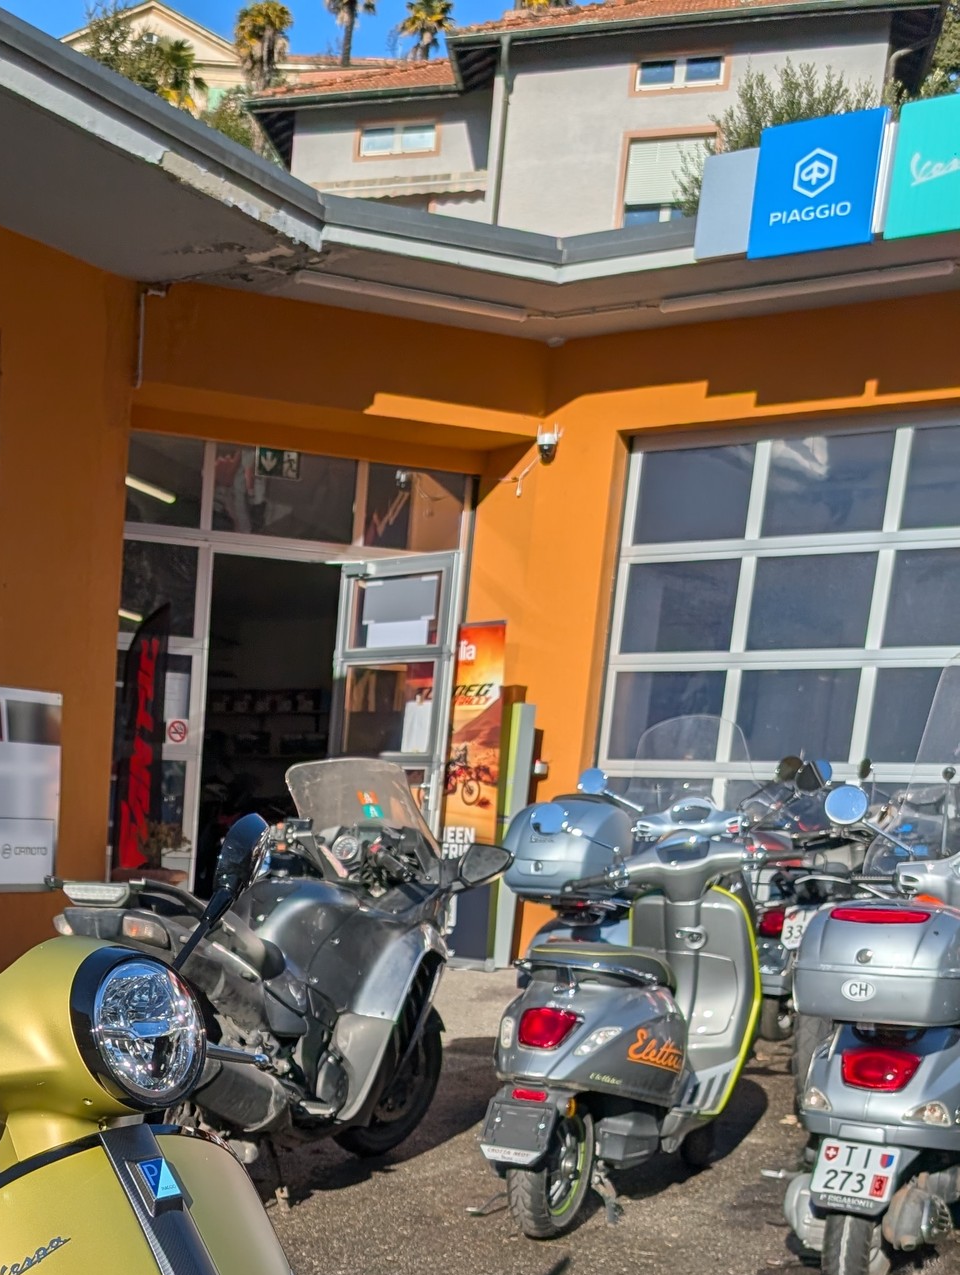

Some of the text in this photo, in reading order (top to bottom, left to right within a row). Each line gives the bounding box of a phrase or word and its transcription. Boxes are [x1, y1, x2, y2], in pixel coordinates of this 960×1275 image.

[769, 201, 852, 226] PIAGGIO
[442, 827, 476, 844] EEN
[848, 983, 868, 997] CH
[845, 1145, 872, 1169] TI
[141, 1163, 159, 1186] P
[822, 1169, 866, 1193] 273
